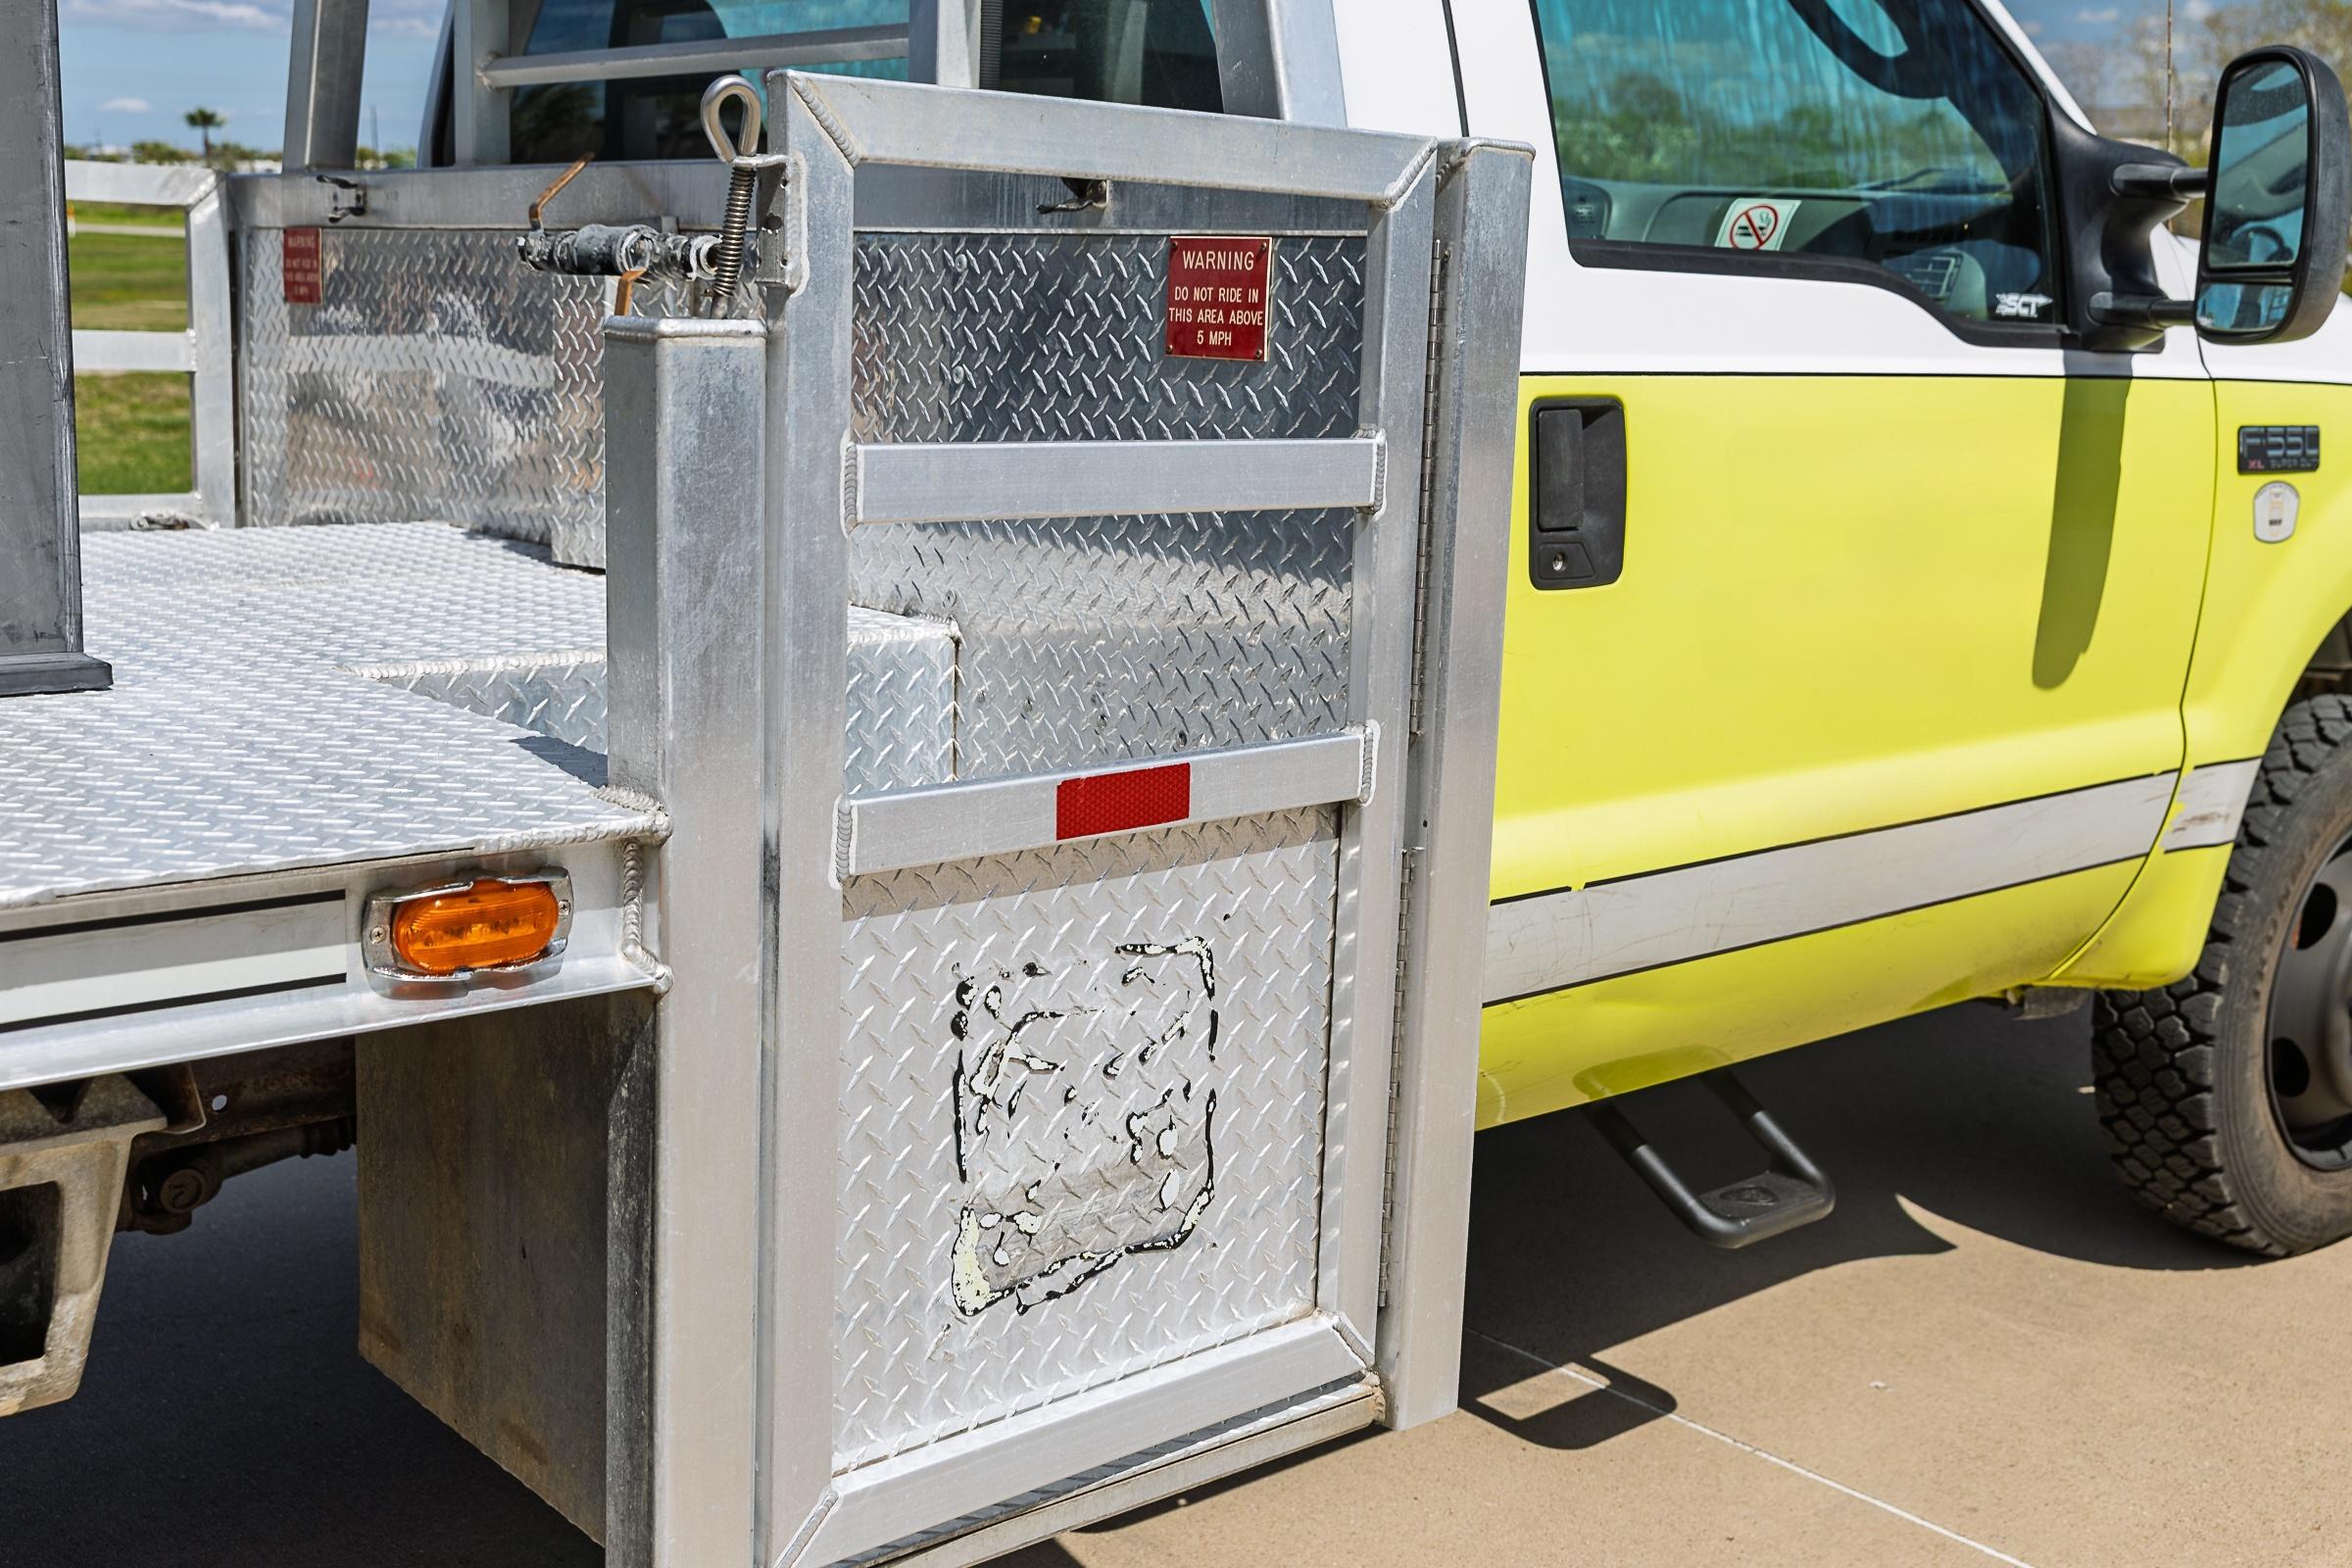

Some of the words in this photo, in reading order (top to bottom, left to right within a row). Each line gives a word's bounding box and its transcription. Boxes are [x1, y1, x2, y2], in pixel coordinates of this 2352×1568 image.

[1183, 250, 1254, 270] WARNING
[1174, 286, 1189, 301] DO
[1193, 286, 1213, 302] NOT
[1218, 287, 1243, 303] RIDE
[1248, 288, 1259, 304] IN
[1168, 307, 1193, 322] THIS
[1197, 309, 1224, 324] AREA
[1228, 310, 1263, 326] ABOVE
[1197, 330, 1204, 345] 5
[1209, 330, 1232, 346] MPH
[2247, 458, 2265, 470] XL
